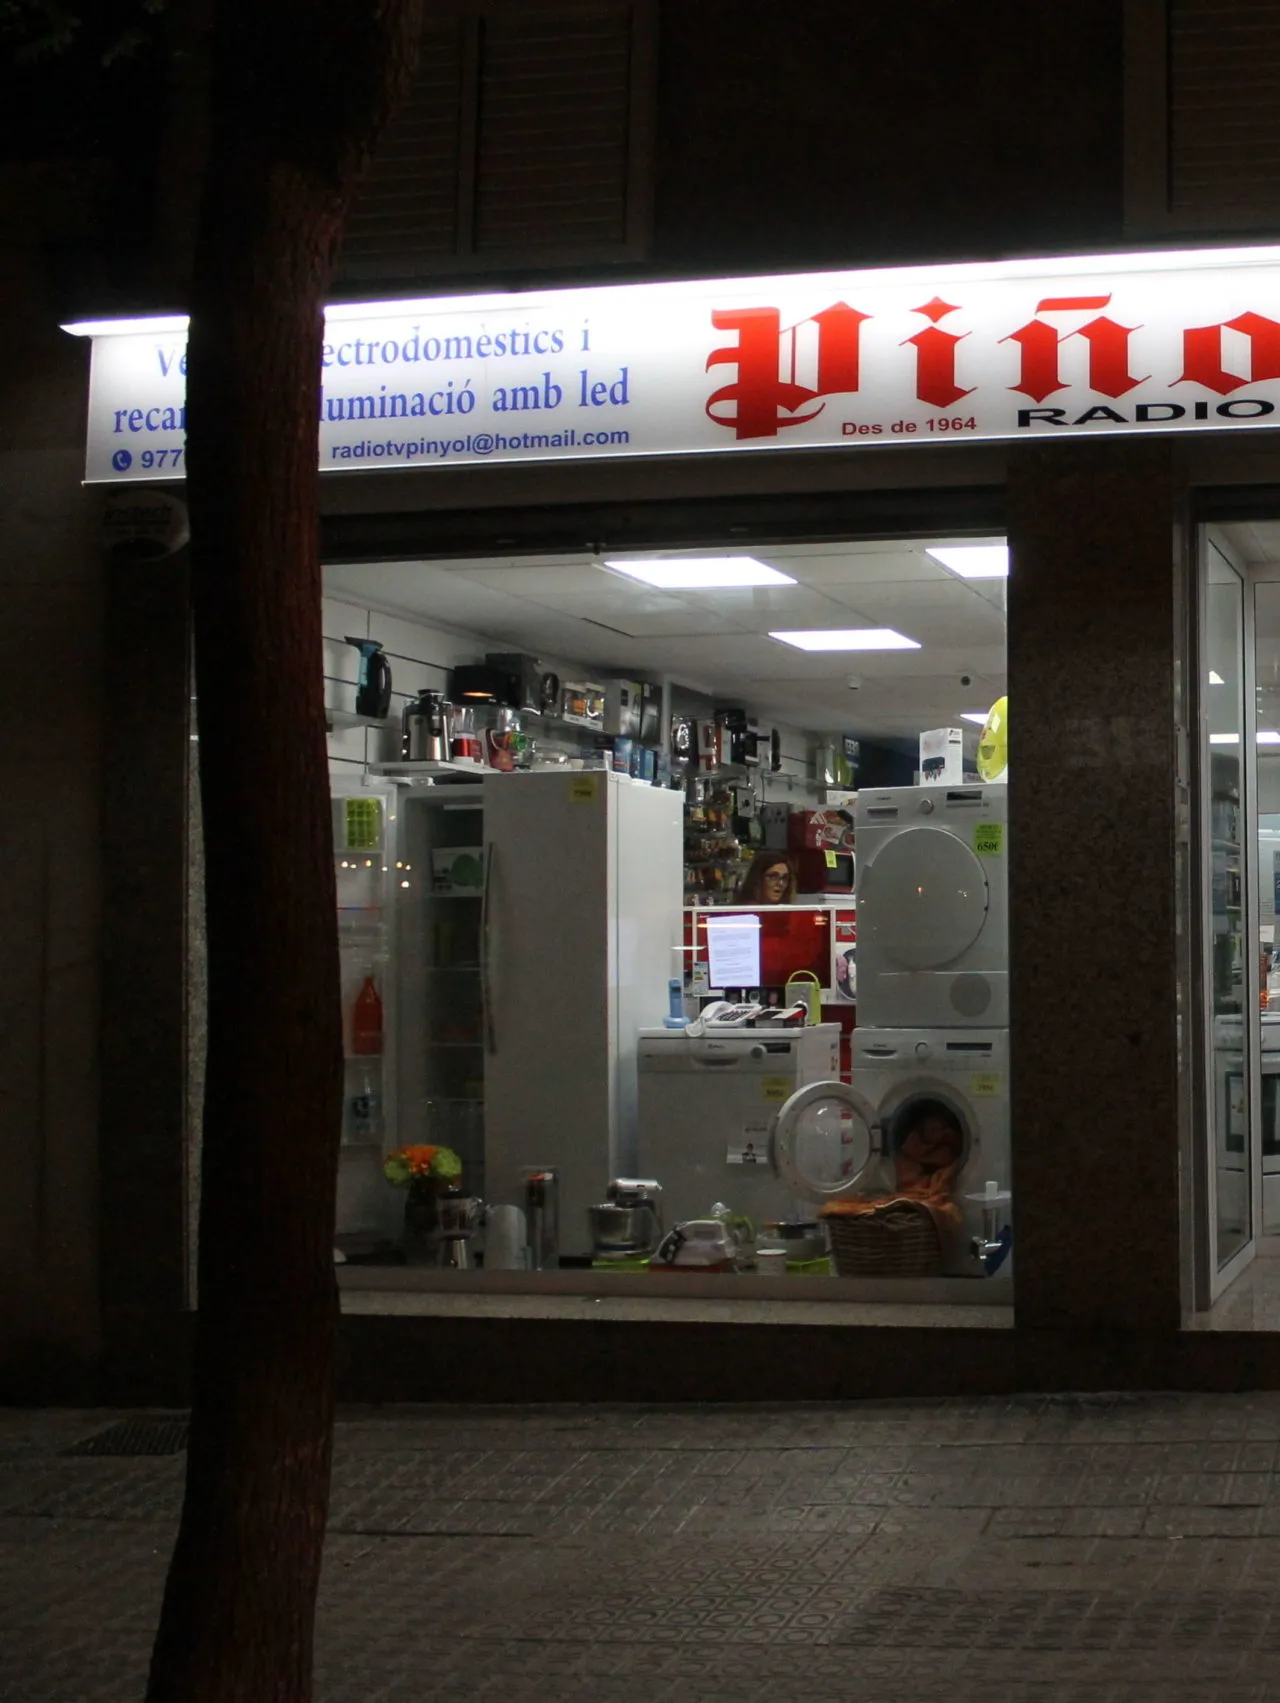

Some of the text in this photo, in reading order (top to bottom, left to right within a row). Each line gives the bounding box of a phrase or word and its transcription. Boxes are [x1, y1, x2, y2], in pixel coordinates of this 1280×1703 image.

[321, 323, 564, 366] ectrodomèstics
[580, 318, 591, 350] i
[112, 366, 630, 433] reca luminació amb led
[1017, 399, 1275, 428] RADIO
[841, 416, 977, 436] Des de 1964
[331, 431, 630, 460] radiotvpinyol@hotmail.com
